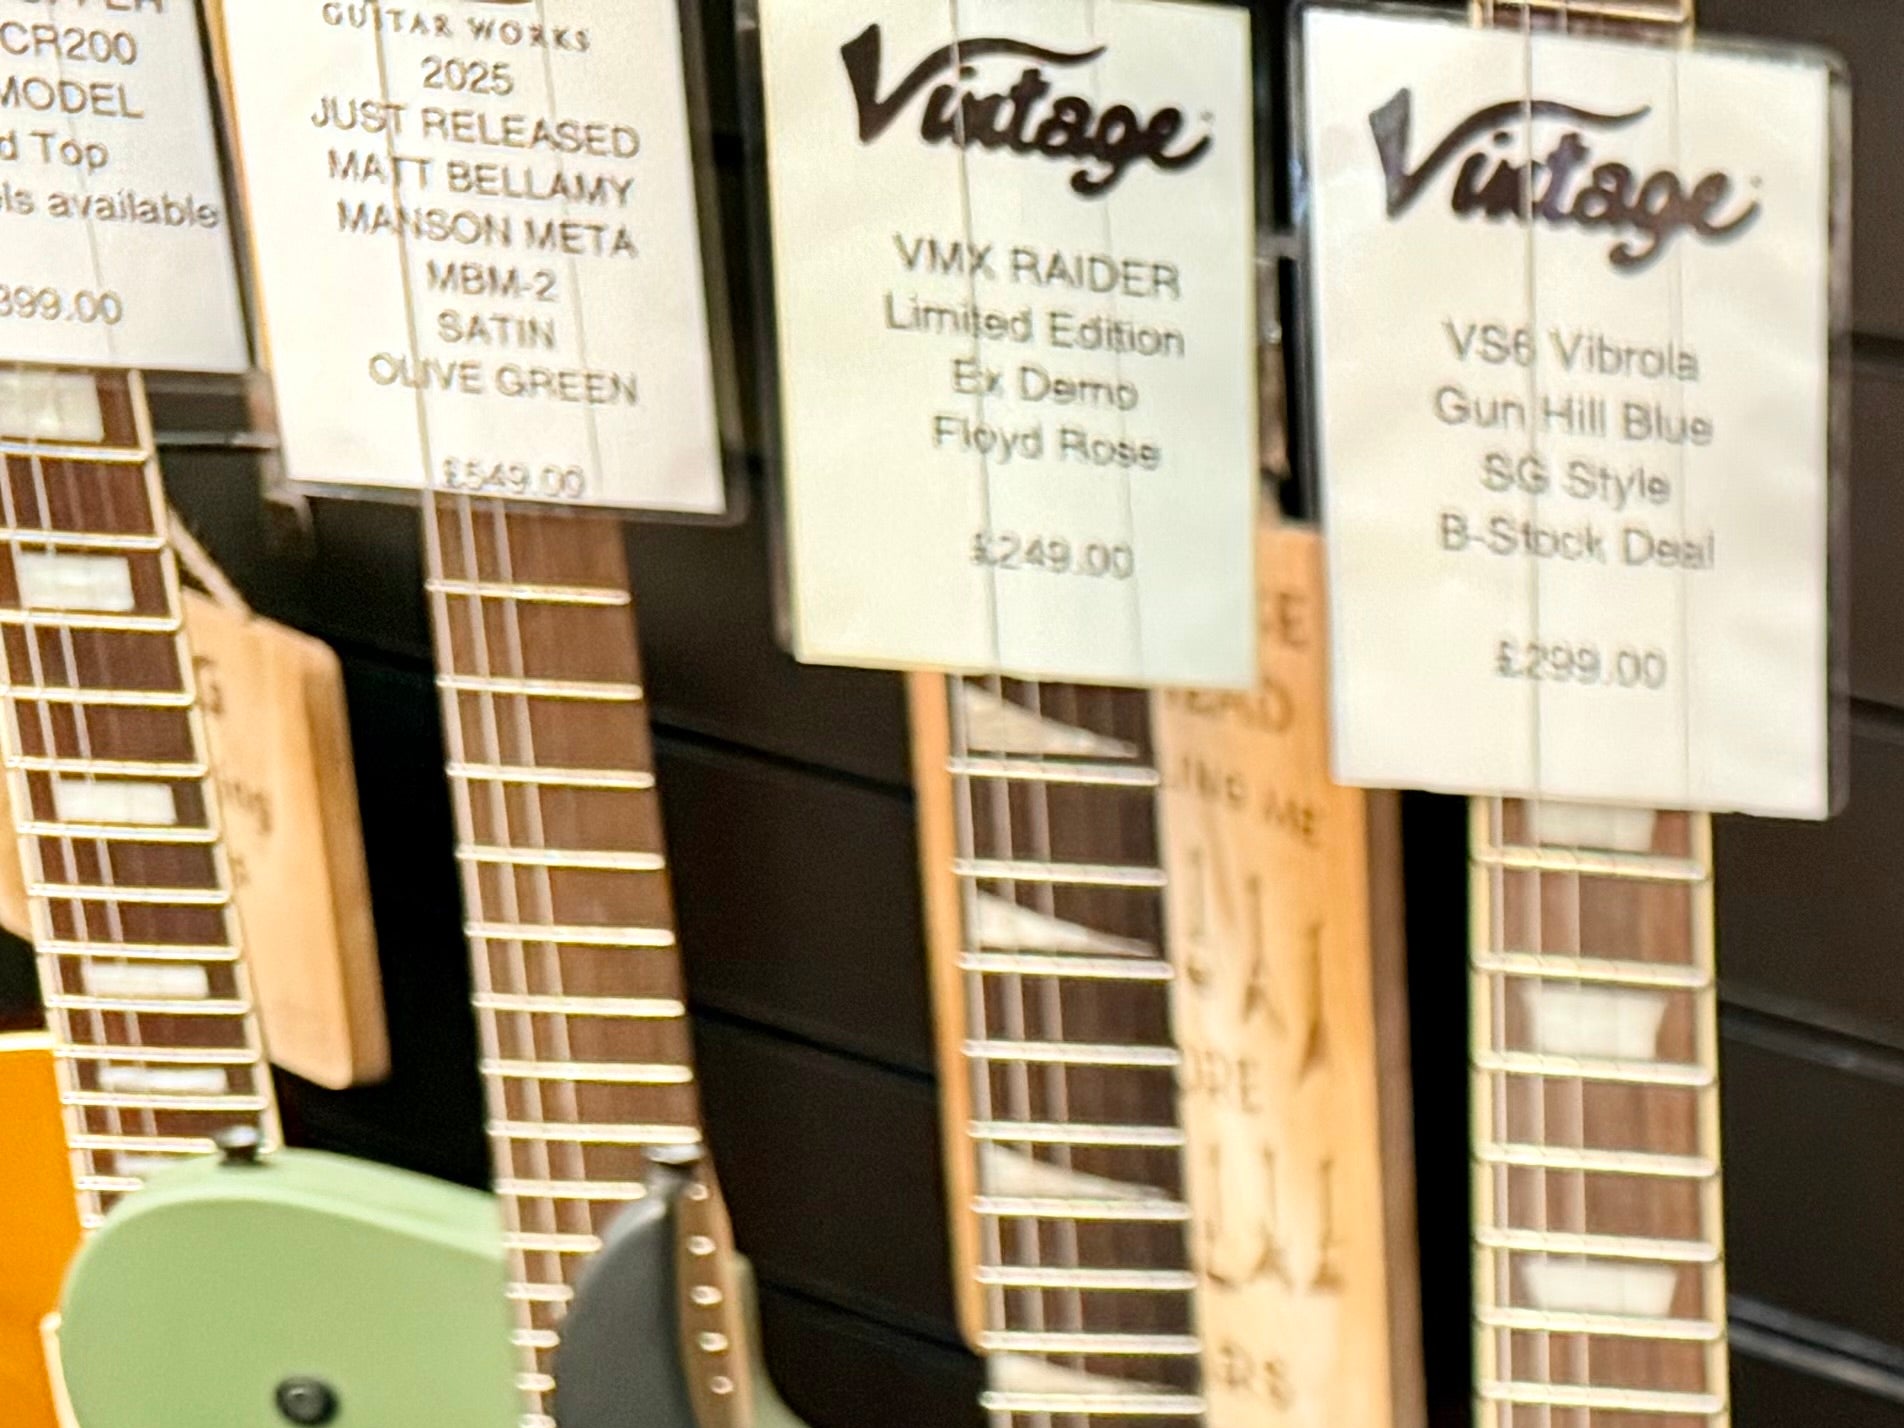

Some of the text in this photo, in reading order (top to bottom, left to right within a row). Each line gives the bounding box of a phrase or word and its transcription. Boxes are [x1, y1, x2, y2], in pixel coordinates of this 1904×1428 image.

[467, 17, 591, 52] WORKS
[420, 54, 515, 96] 2025
[311, 96, 641, 159] JUST RELEASED
[839, 23, 1213, 199] Vintage
[29, 131, 109, 175] Top
[328, 148, 634, 208] MATT BELLAMY
[1368, 86, 1762, 276] Vintage
[48, 186, 219, 229] available
[336, 200, 640, 258] MANSON META
[427, 261, 558, 301] MBM-2
[893, 232, 1181, 301] VMX RAIDER
[436, 311, 557, 349] SATIN
[883, 291, 1185, 359] Limited Edition
[1443, 318, 1700, 382] VS6 Vibrola
[368, 351, 639, 406] OLIVE GREEN
[950, 357, 1139, 410] Ex Demo
[933, 414, 1163, 471] Floyd Rose
[1433, 384, 1715, 448] Gun Hill Blue
[441, 456, 587, 498] £549.00
[1480, 452, 1672, 512] SG Style
[970, 532, 1136, 580] £249.00
[1438, 510, 1717, 573] B-Stock Deal
[1497, 639, 1670, 691] £299.00
